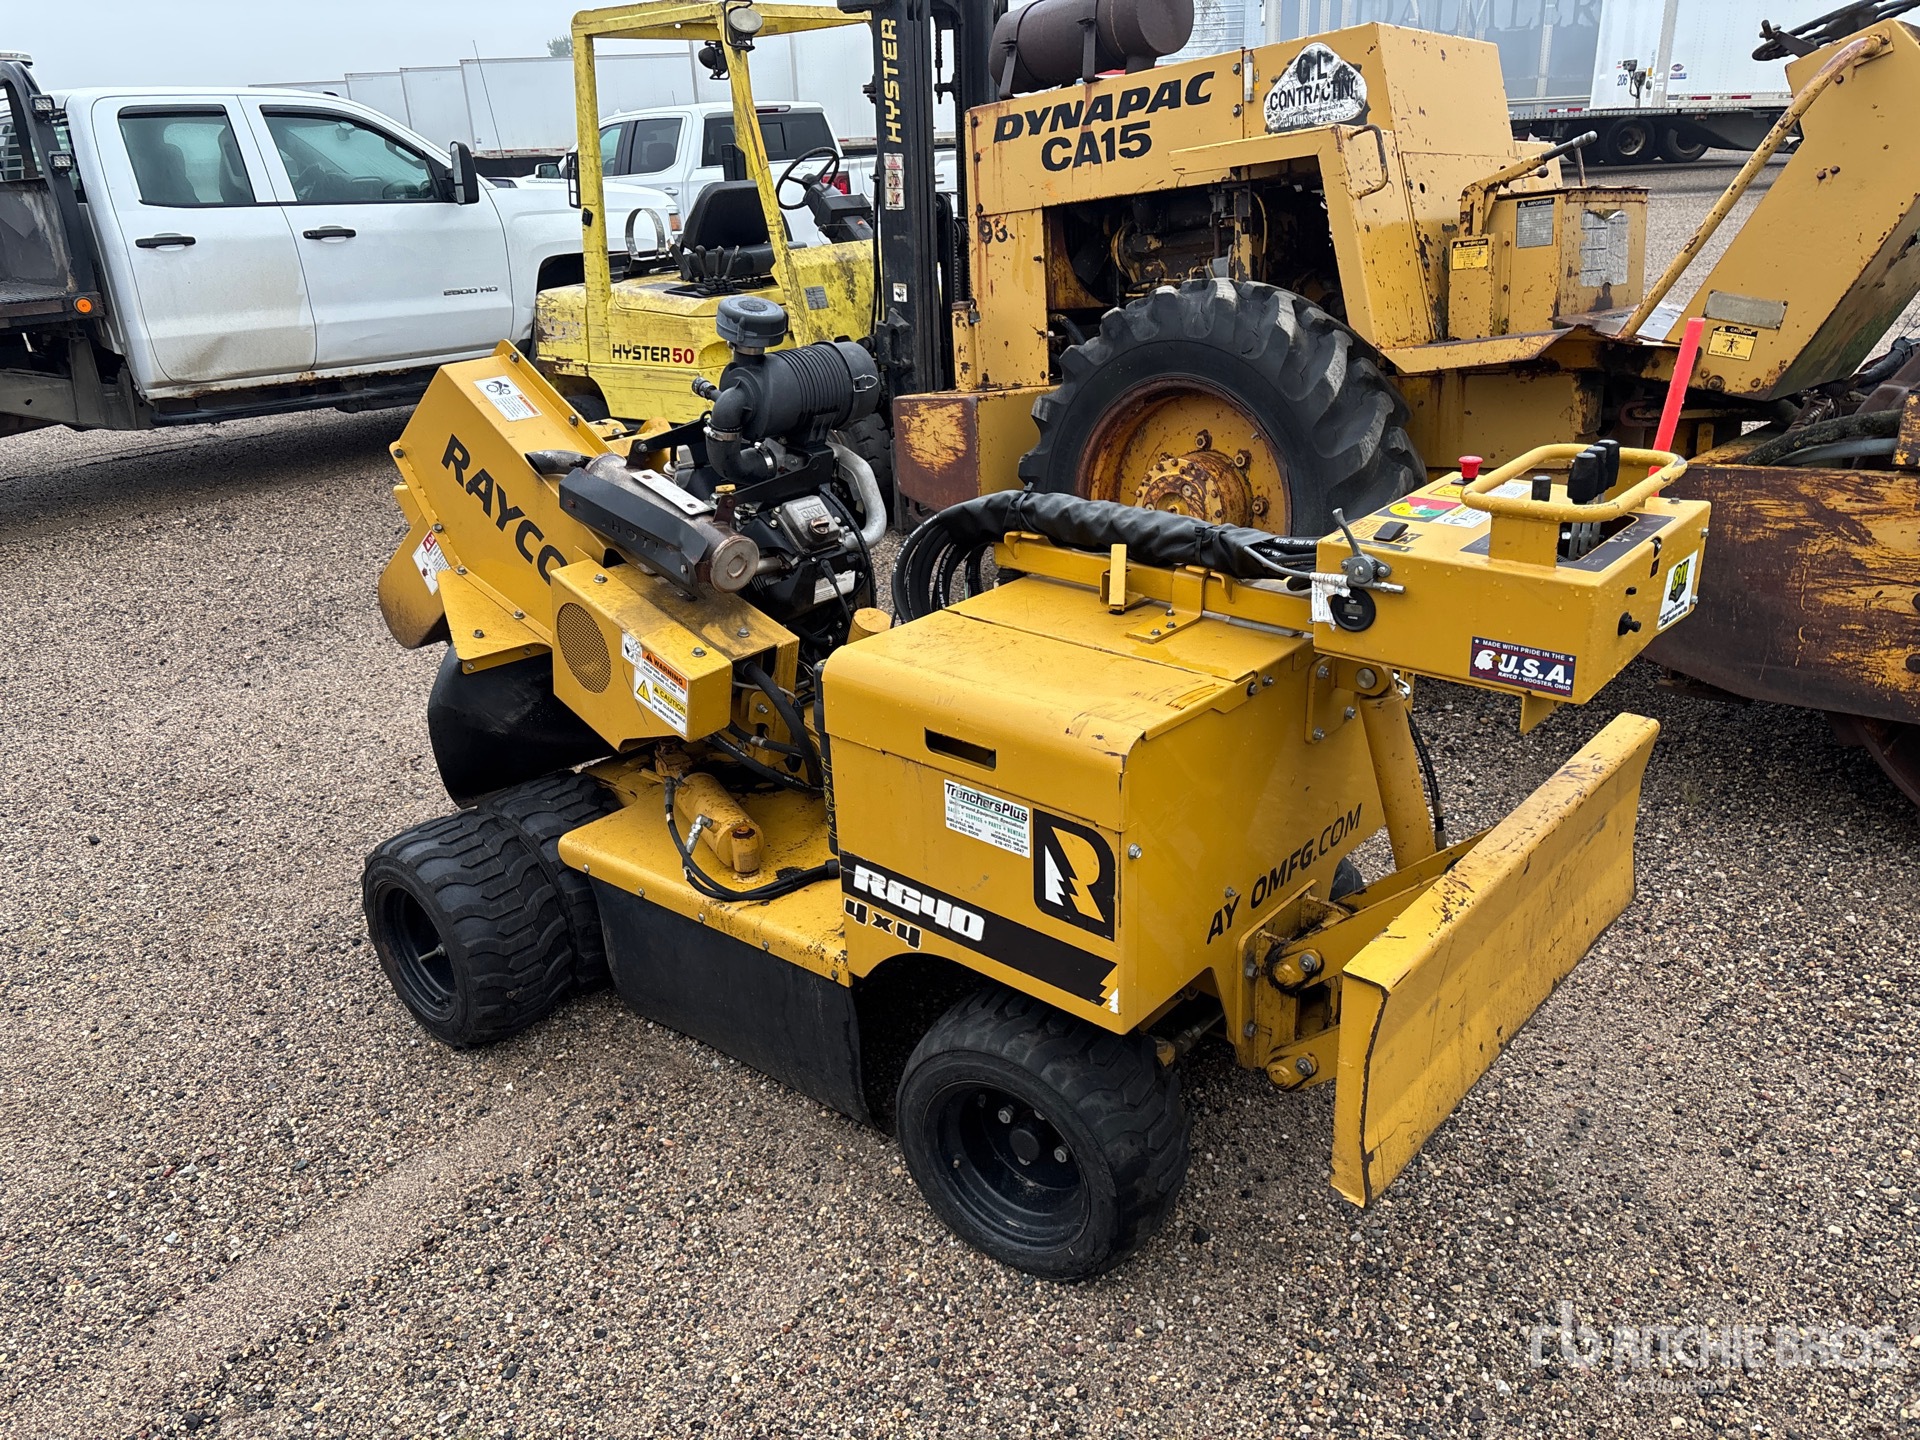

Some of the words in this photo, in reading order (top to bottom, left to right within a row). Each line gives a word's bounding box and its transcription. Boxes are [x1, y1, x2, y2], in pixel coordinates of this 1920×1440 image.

[880, 18, 902, 144] HYSTER
[1269, 75, 1358, 111] CONTRACTING
[1617, 74, 1628, 86] 206
[993, 71, 1215, 144] DYNAPAC
[1041, 120, 1152, 171] CA15
[443, 288, 478, 296] 2500
[612, 343, 670, 362] HYSTER
[672, 347, 695, 365] 50
[1671, 560, 1689, 590] 811
[1482, 640, 1501, 648] MADE
[1502, 644, 1519, 652] WITH
[1520, 647, 1541, 657] PRIDE
[654, 658, 683, 686] WARNING
[1498, 653, 1572, 685] U.S.A.
[1498, 672, 1517, 680] RAYCO
[660, 690, 686, 714] CAUTION
[945, 782, 1028, 822] TrenchersPlus
[988, 820, 1002, 830] PARTS
[1007, 827, 1026, 839] RENTALS
[1207, 893, 1241, 945] AY
[1251, 802, 1362, 909] OMFG.COM
[853, 864, 985, 942] RG40
